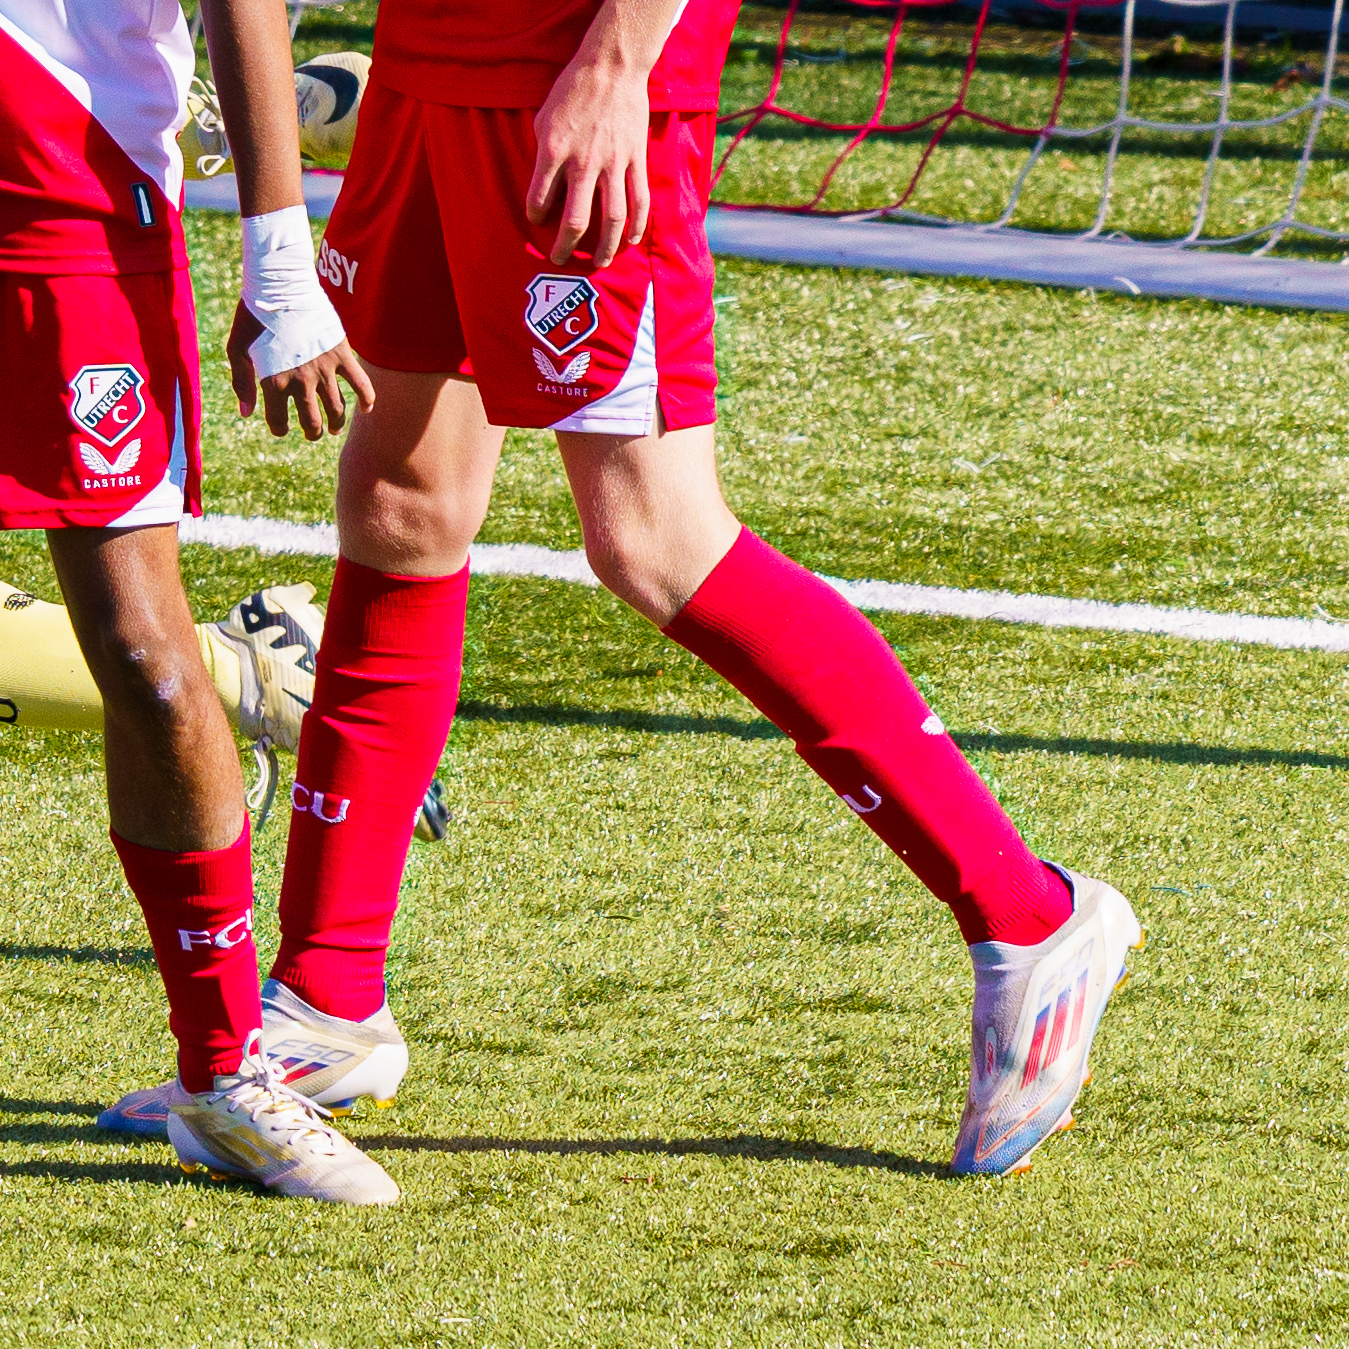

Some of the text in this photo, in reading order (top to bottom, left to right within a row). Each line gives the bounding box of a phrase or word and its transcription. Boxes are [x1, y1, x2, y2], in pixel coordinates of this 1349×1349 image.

[545, 284, 556, 302] F
[536, 285, 590, 336] UTRECHT
[564, 316, 581, 336] C
[89, 377, 101, 394] F
[536, 383, 588, 397] CASTORE
[83, 372, 136, 428] UTRECHT
[112, 405, 129, 424] C
[84, 475, 142, 489] CASTORE
[290, 781, 351, 824] CU
[841, 784, 883, 814] U
[267, 1038, 356, 1064] F50
